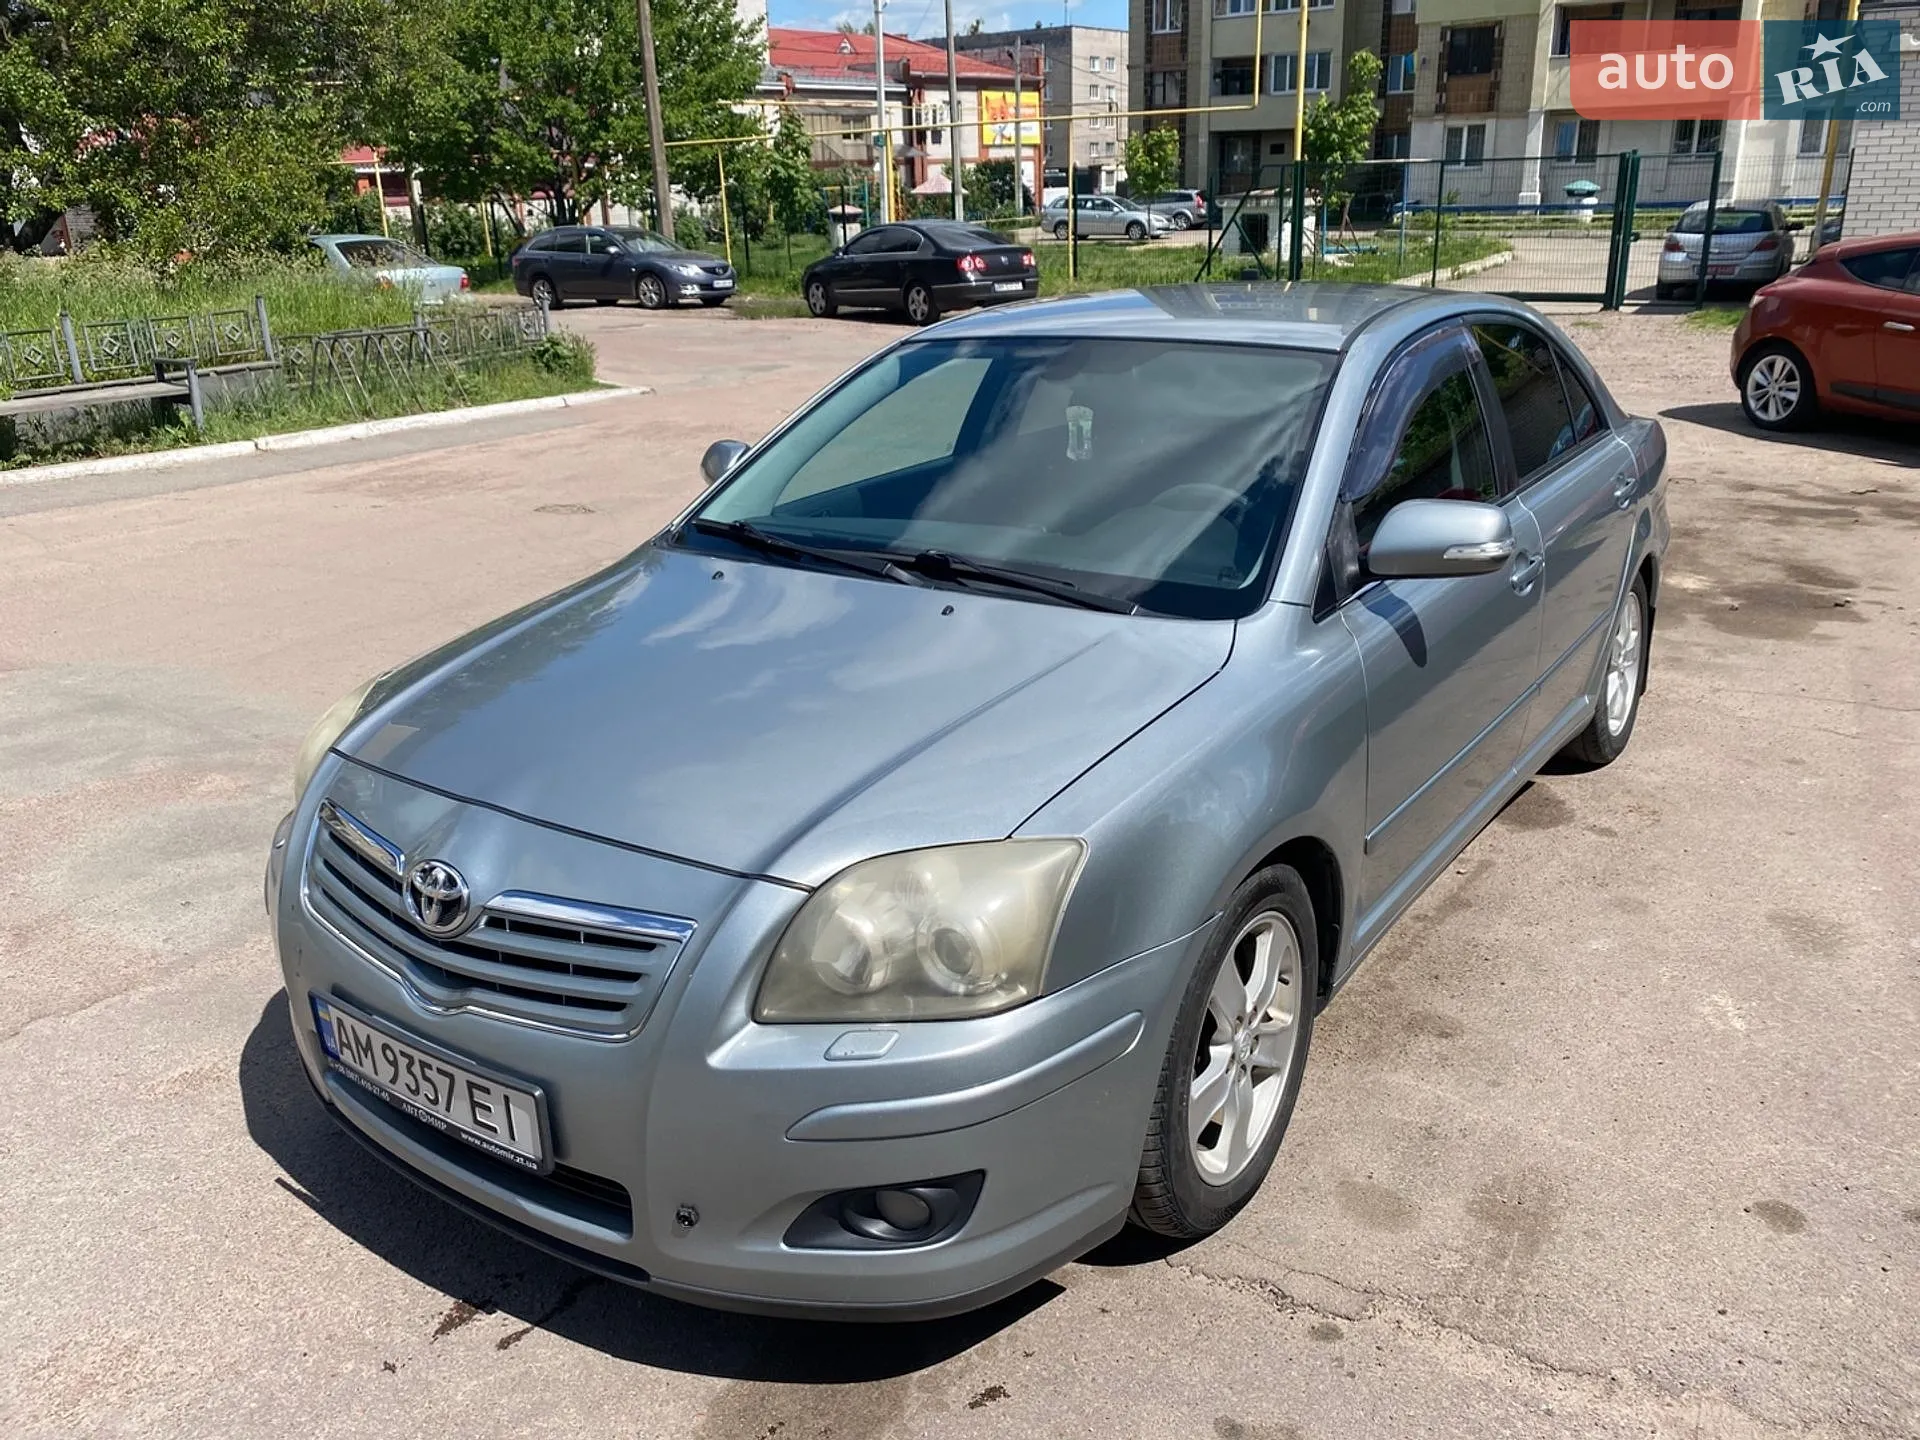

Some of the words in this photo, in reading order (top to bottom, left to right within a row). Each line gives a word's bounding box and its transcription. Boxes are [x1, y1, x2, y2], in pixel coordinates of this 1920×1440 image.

[336, 1016, 378, 1077] AM
[381, 1042, 456, 1113] 9357
[466, 1080, 516, 1142] EI
